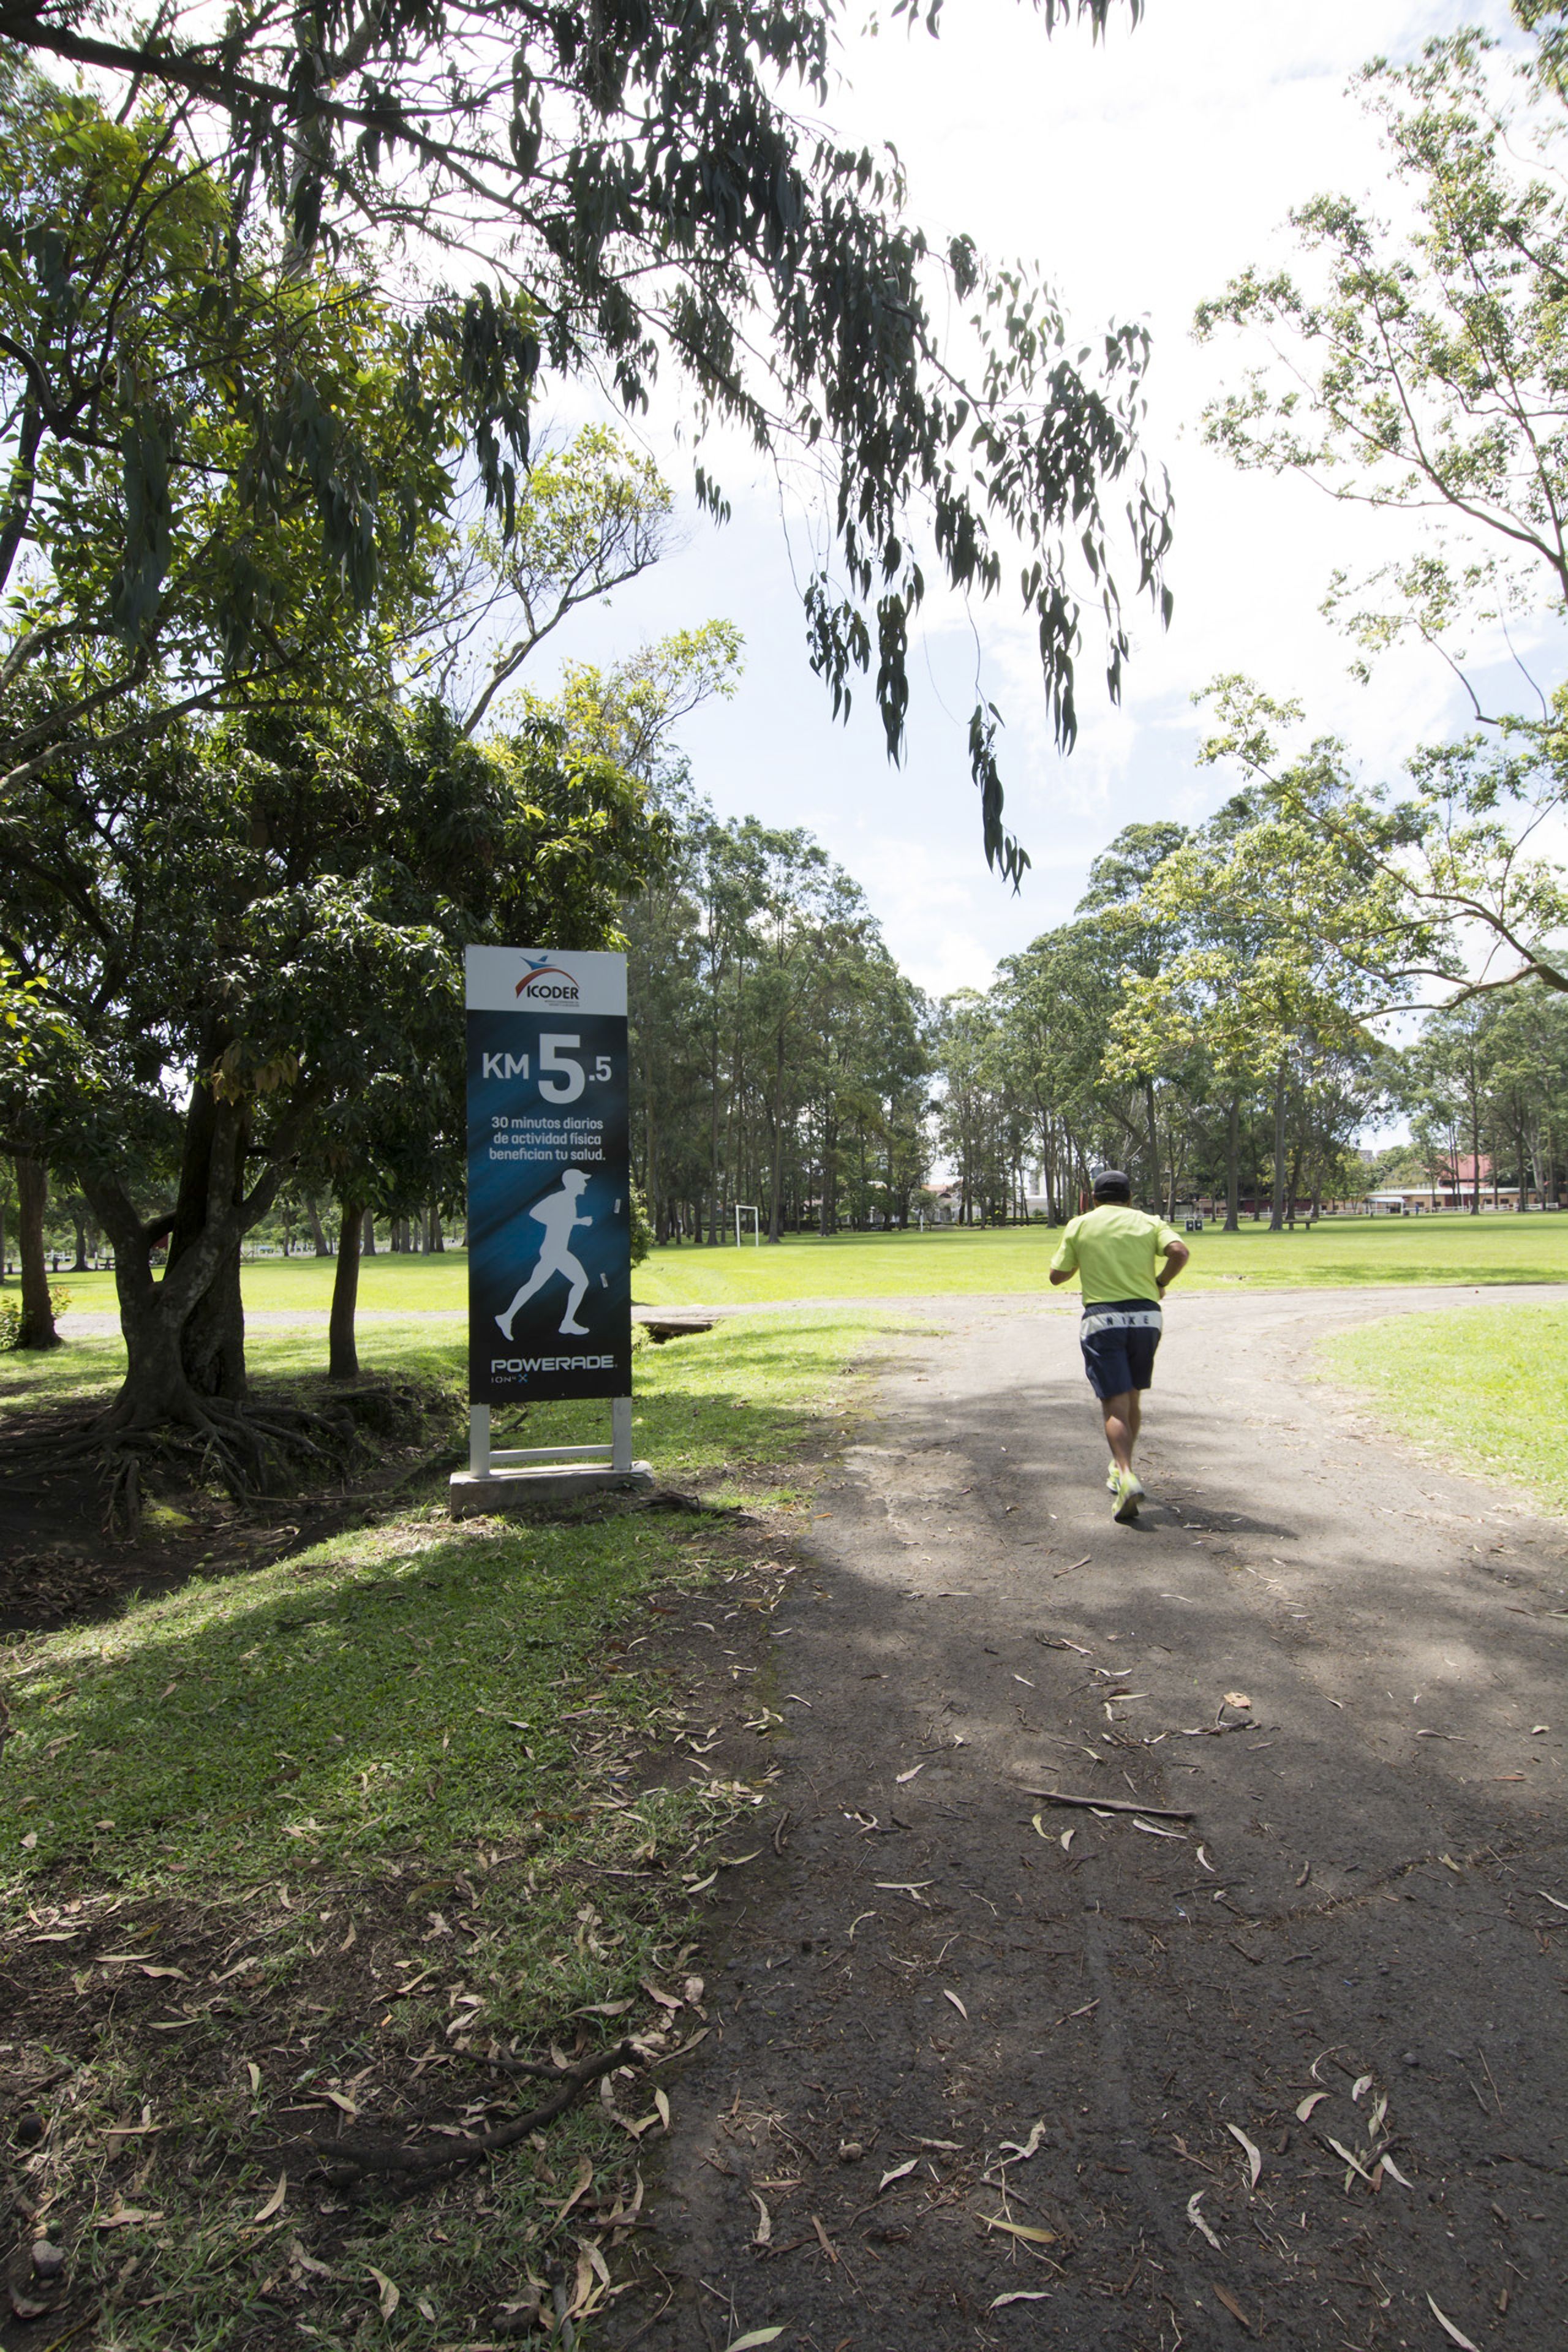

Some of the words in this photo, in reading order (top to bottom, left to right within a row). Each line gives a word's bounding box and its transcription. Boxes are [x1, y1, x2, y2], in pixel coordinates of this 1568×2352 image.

[527, 985, 579, 1000] ICODER
[483, 1052, 529, 1079] KM
[491, 1117, 508, 1128] 30
[511, 1117, 561, 1129] minutos
[564, 1117, 603, 1130] diarios
[494, 1132, 509, 1144] de
[511, 1132, 567, 1145] actividad
[570, 1133, 601, 1145] física
[489, 1147, 552, 1160] benefician
[555, 1149, 568, 1160] tu
[570, 1148, 606, 1161] salud.
[1106, 1315, 1149, 1326] NIKE
[491, 1355, 615, 1373] POWERADE
